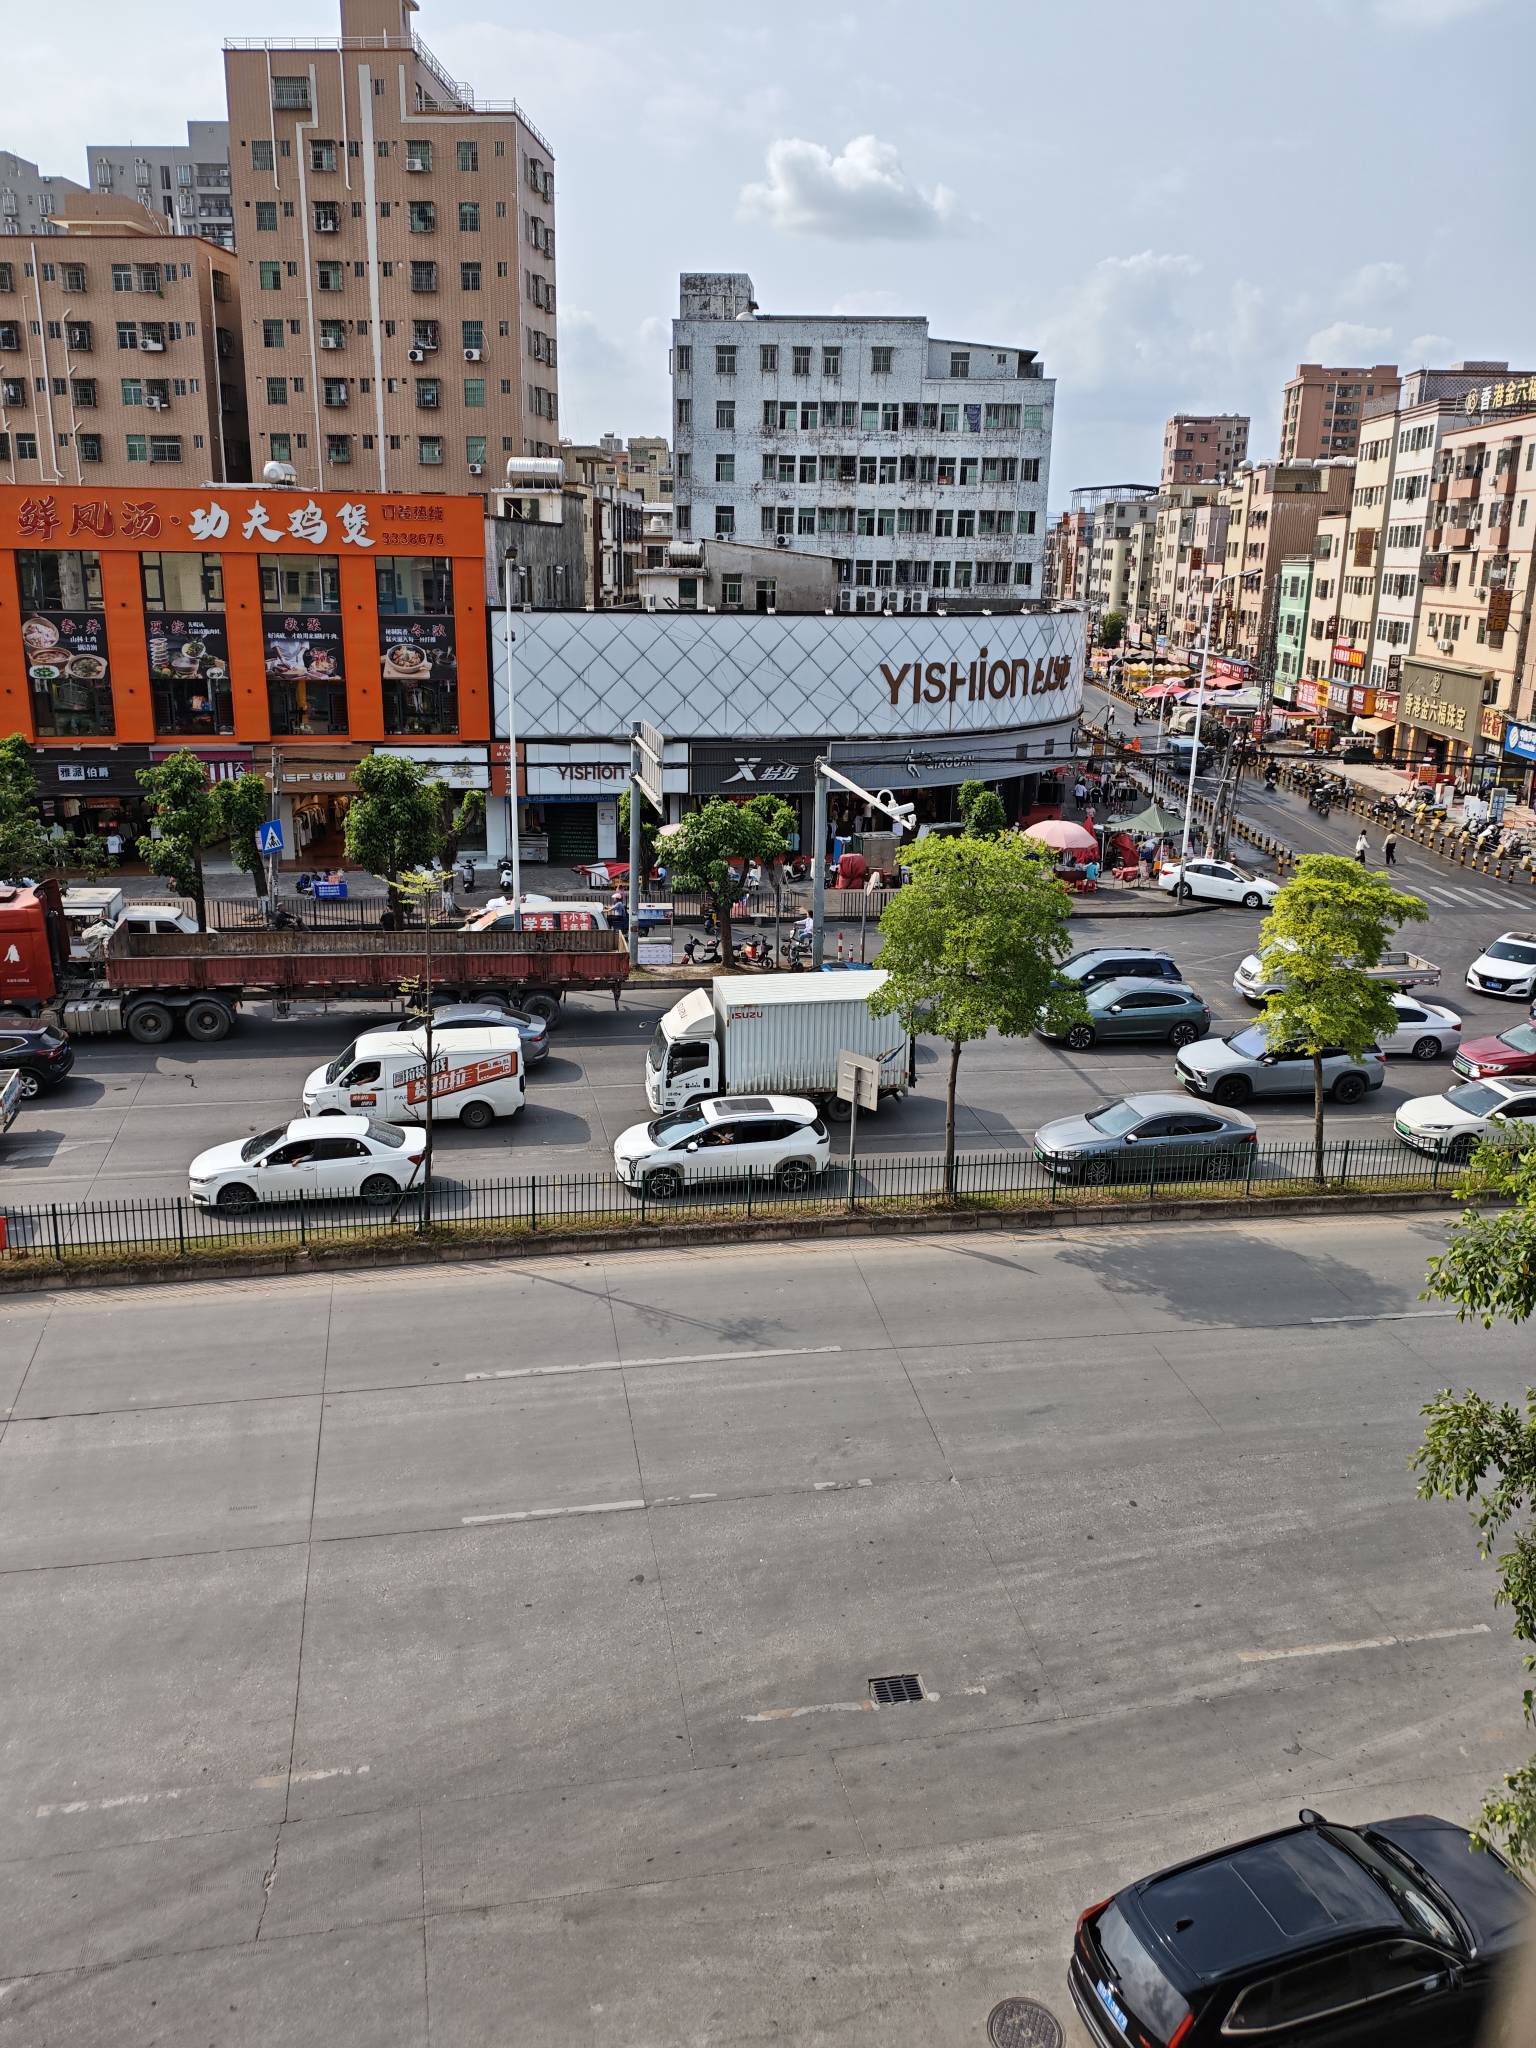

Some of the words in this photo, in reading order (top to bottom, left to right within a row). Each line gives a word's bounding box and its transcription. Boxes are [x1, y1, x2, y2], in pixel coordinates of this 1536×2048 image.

[1405, 693, 1466, 732] 香港金六福珠宝
[60, 767, 110, 779] 雅派伯爵
[523, 917, 554, 931] 学车
[731, 1011, 763, 1020] ISUZU
